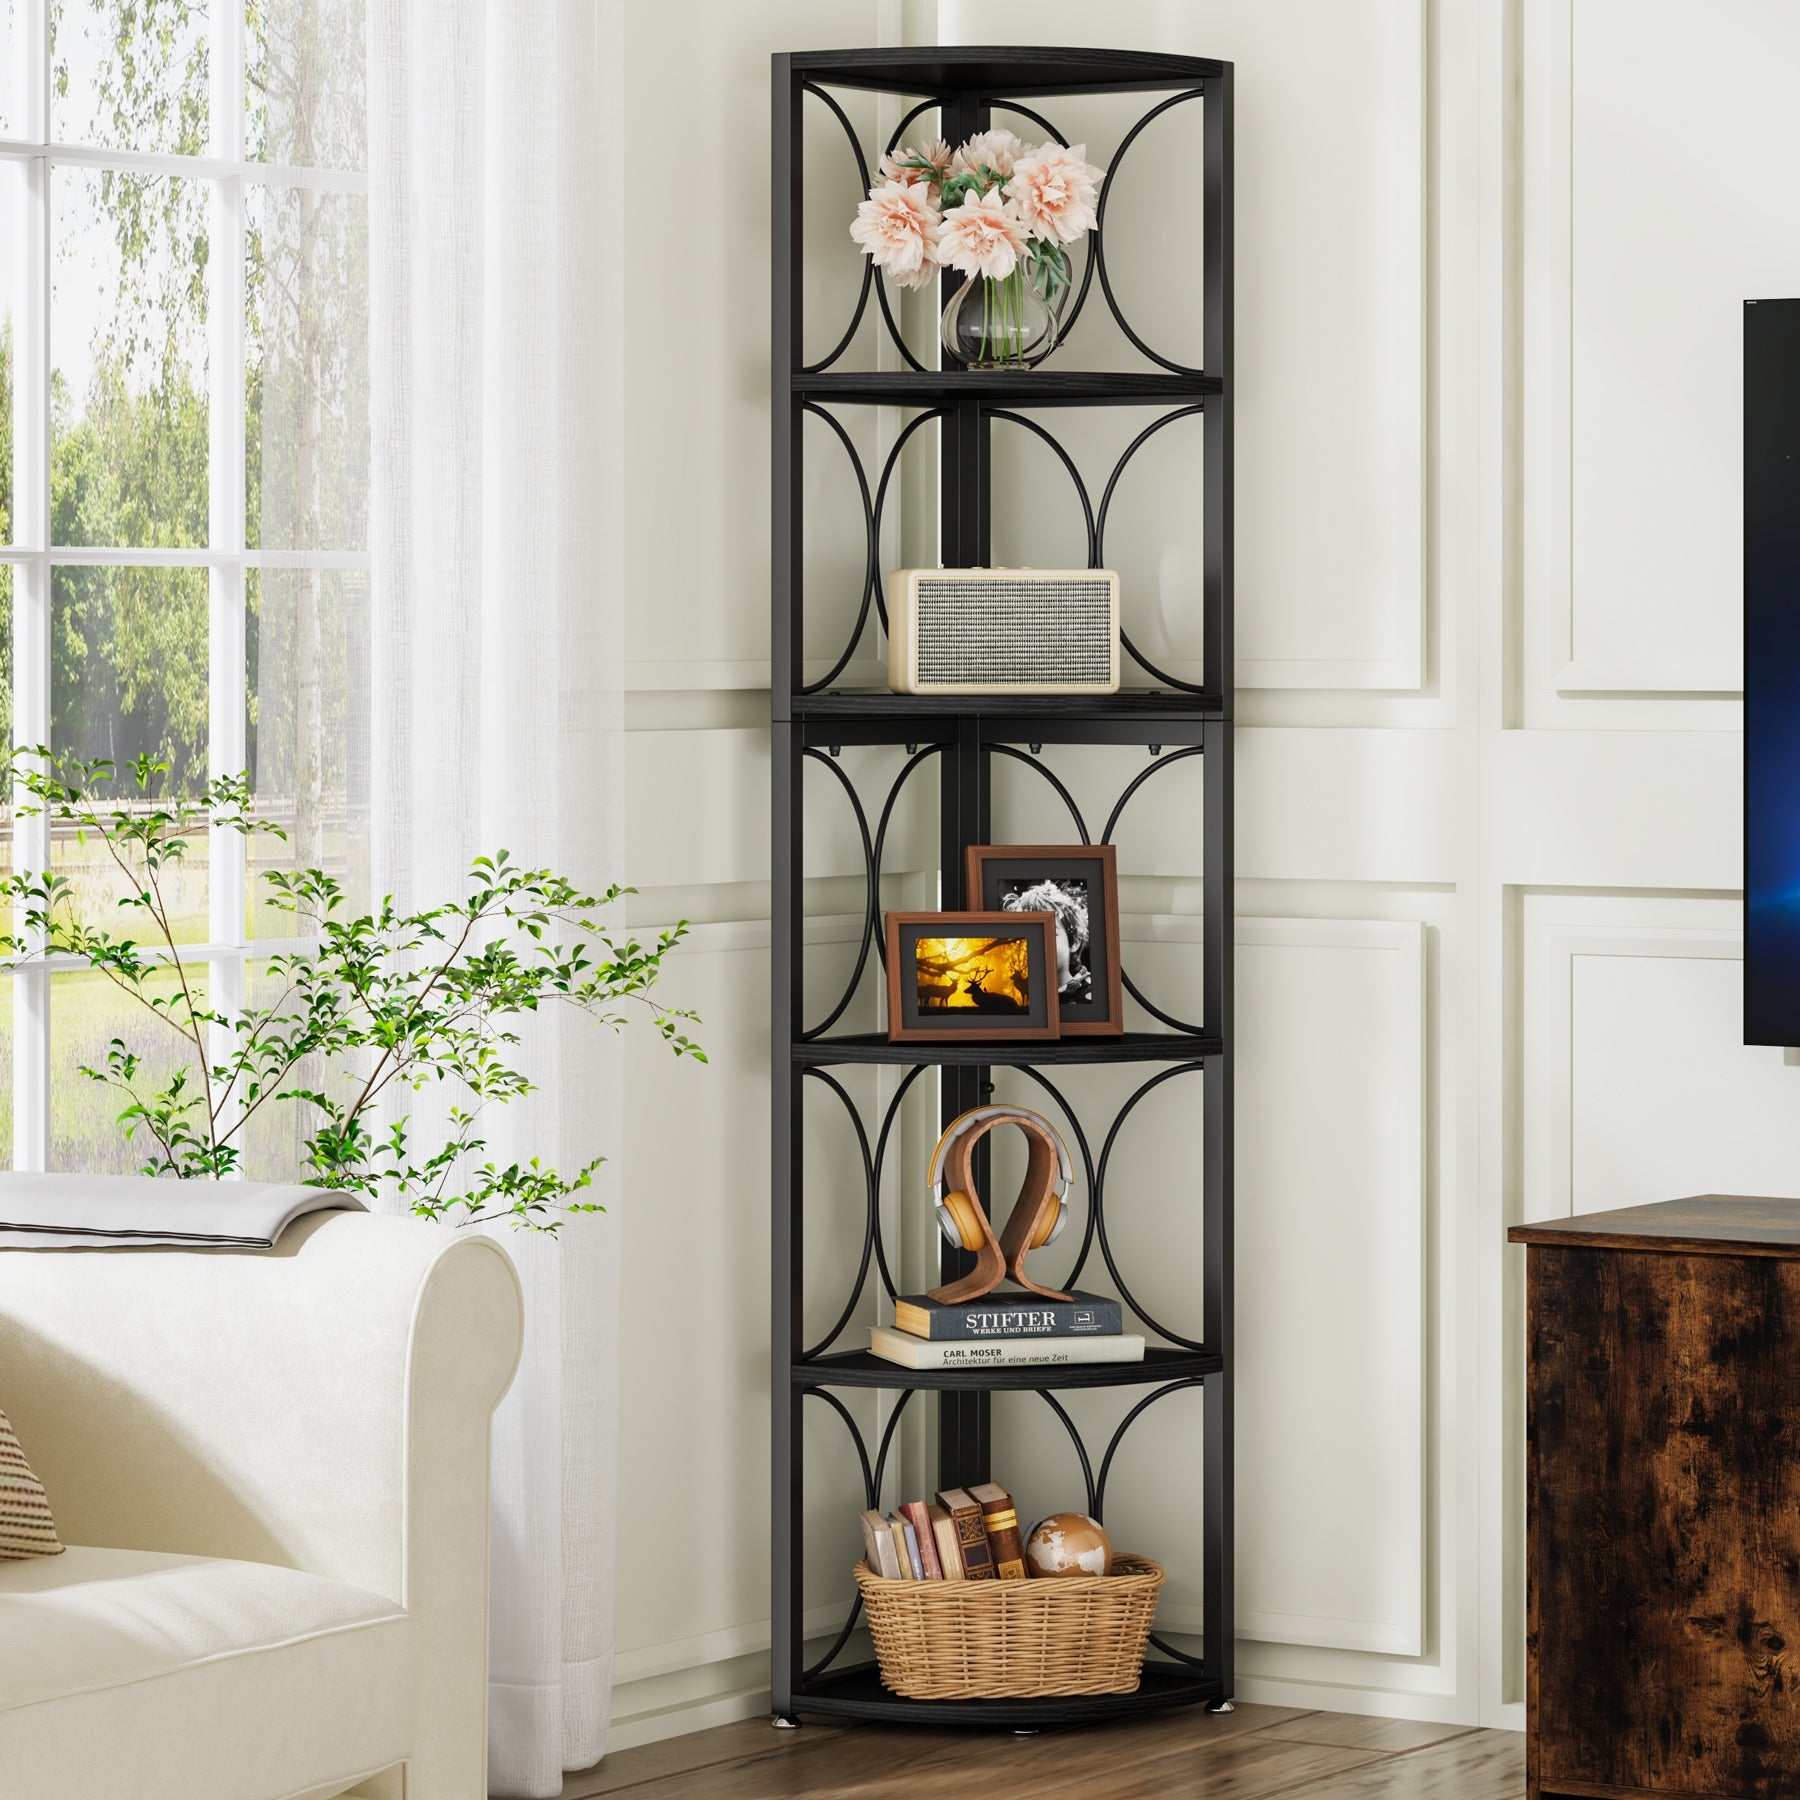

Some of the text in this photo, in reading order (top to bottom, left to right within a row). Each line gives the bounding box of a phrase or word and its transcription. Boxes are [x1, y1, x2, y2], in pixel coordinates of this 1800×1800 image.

[966, 1311, 1057, 1329] STIFTER
[943, 1348, 1002, 1358] CARL MOSER
[943, 1357, 991, 1365] Architektur
[993, 1355, 1005, 1364] für
[1052, 1354, 1068, 1362] Zeit
